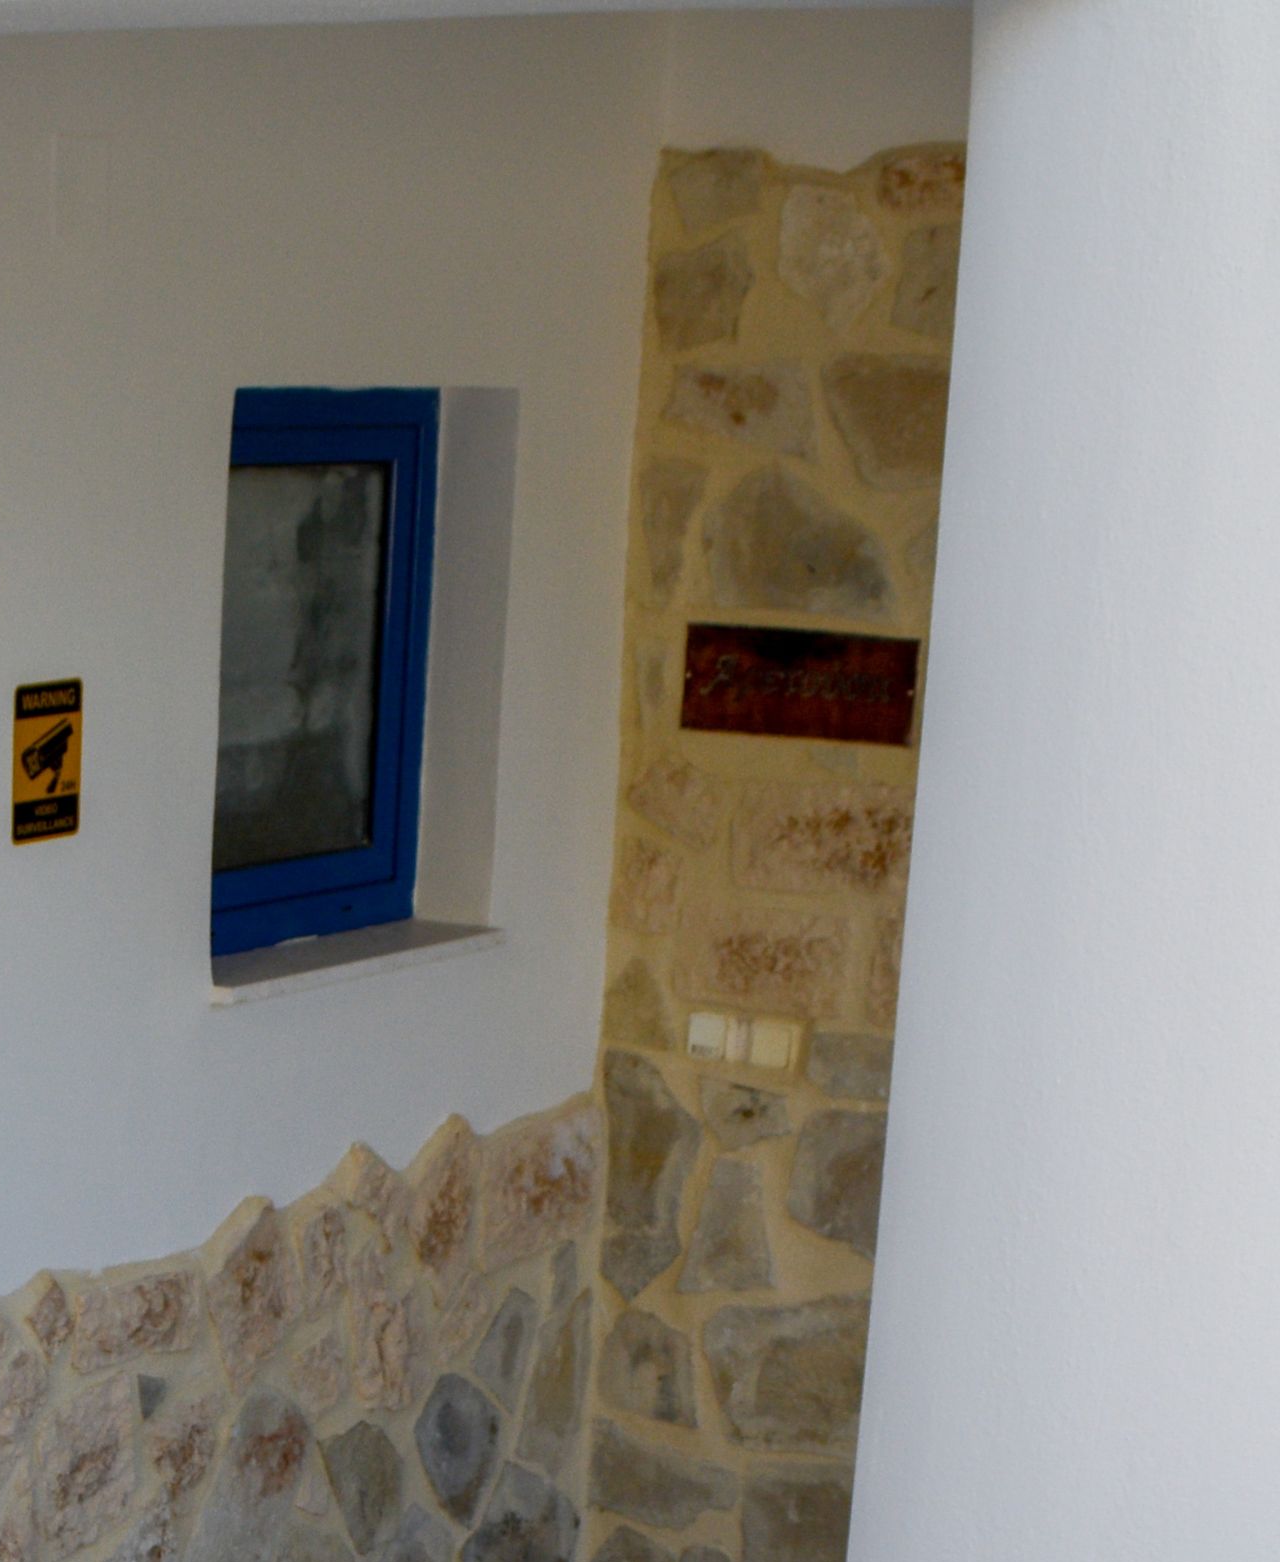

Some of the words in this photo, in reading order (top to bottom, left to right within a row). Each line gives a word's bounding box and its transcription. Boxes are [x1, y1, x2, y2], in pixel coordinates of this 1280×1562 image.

[22, 689, 76, 711] WARNING
[34, 803, 58, 817] VIDEO
[16, 817, 74, 836] SURVEILLANCE
